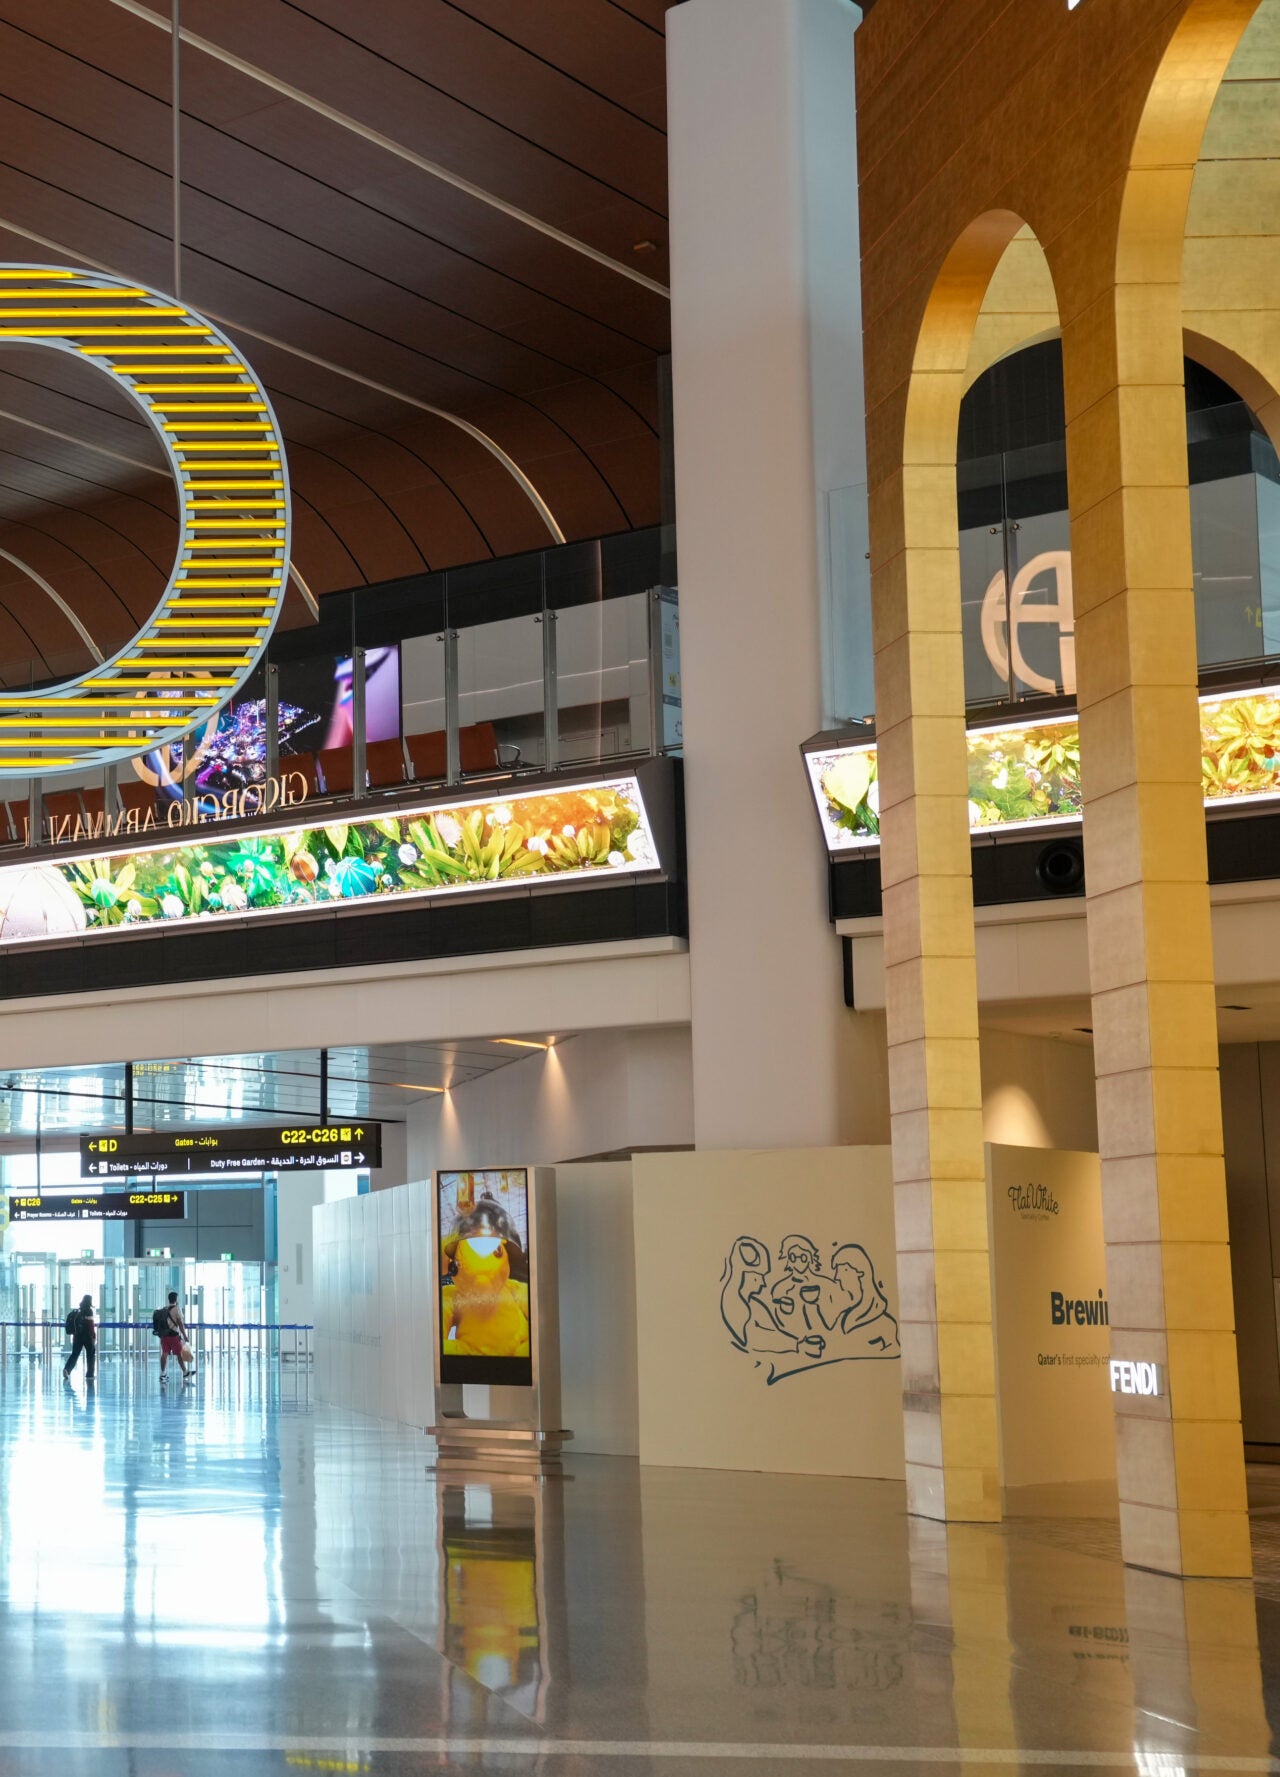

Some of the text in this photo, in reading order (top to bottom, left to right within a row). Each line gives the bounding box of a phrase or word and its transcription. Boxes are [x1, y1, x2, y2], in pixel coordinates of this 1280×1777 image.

[175, 1138, 194, 1147] Gates
[281, 1129, 339, 1144] C22-C26
[109, 1139, 118, 1152] D
[109, 1163, 129, 1172] Toilets
[210, 1159, 225, 1168] Duty
[226, 1159, 241, 1167] Free
[241, 1158, 266, 1166] Garden
[1037, 1353, 1062, 1367] Qatar's
[1109, 1360, 1158, 1396] FENDI
